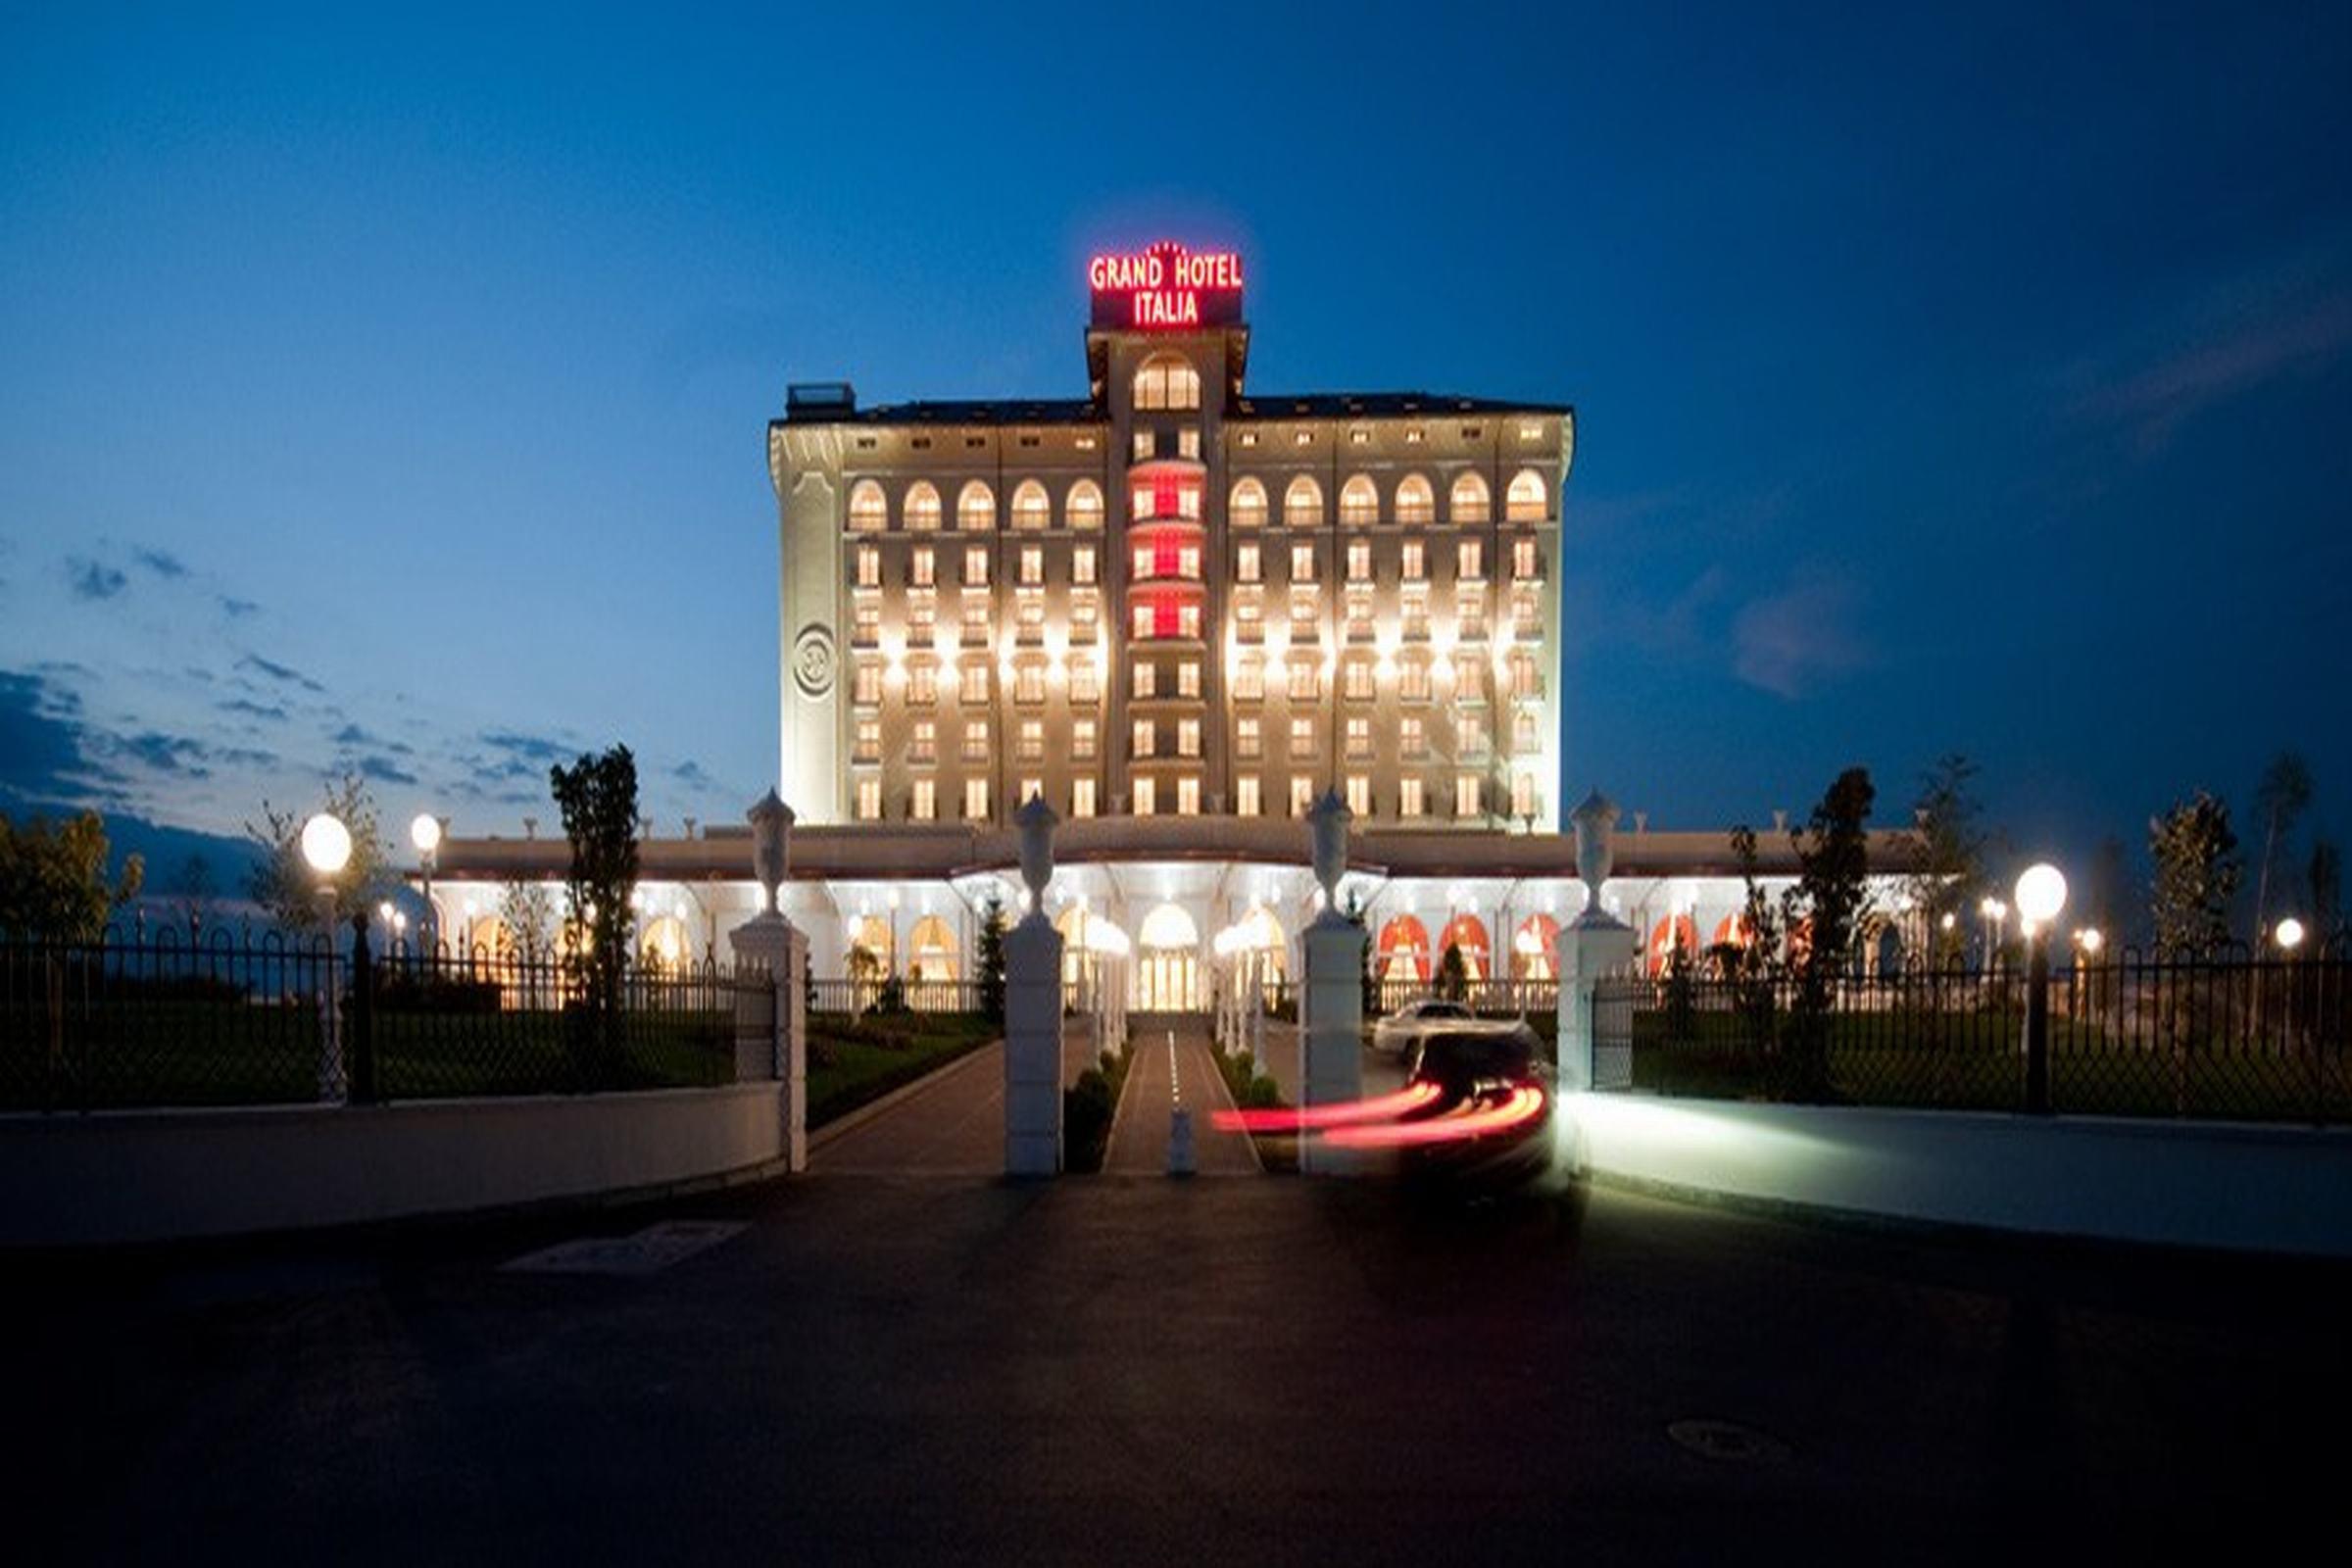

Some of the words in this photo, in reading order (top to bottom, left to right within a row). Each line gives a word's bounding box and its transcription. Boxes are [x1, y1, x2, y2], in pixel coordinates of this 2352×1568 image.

[1090, 256, 1163, 289] GRAND
[1175, 253, 1243, 287] HOTEL
[1134, 291, 1199, 323] ITALIA
